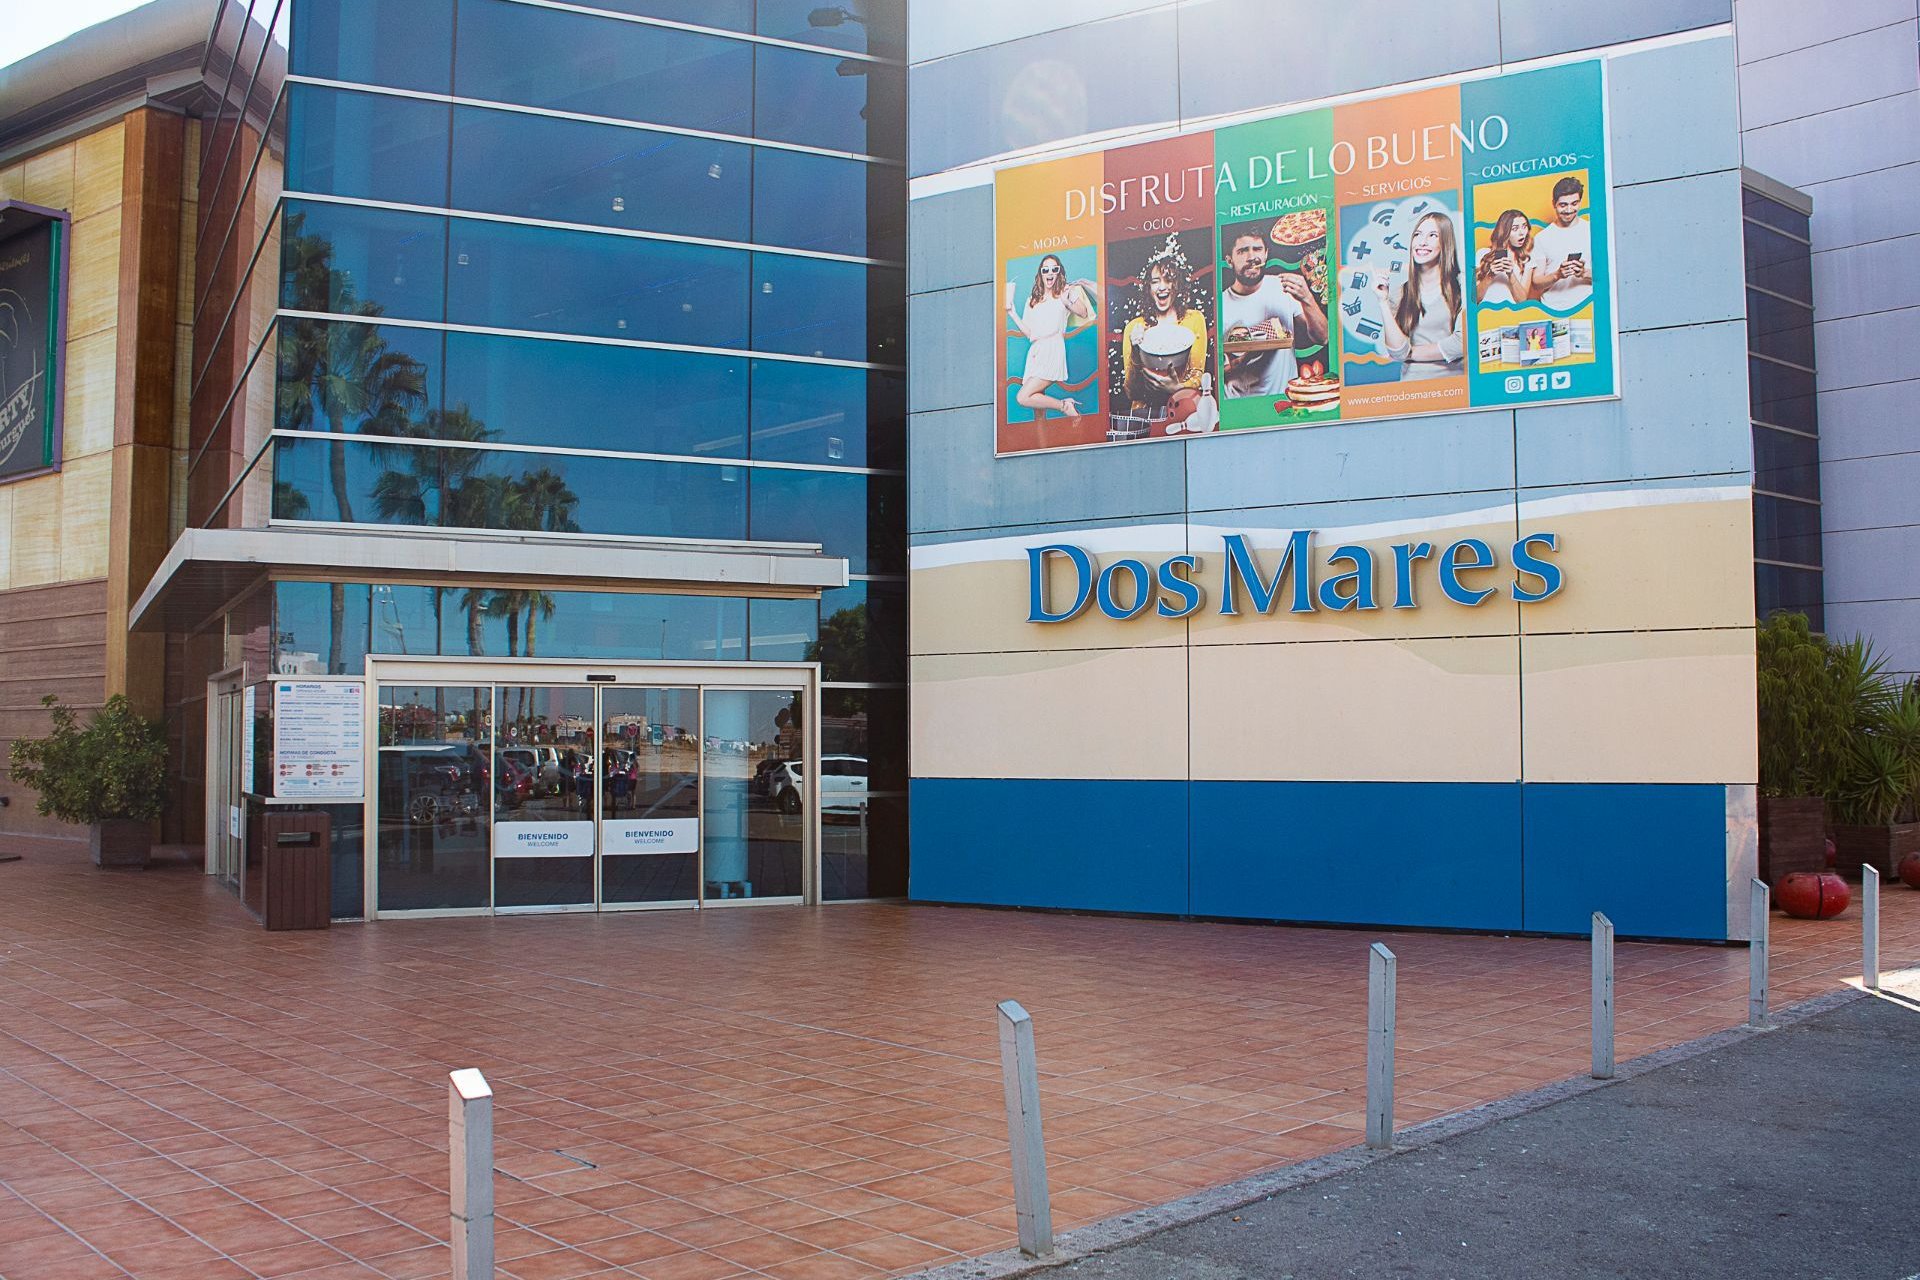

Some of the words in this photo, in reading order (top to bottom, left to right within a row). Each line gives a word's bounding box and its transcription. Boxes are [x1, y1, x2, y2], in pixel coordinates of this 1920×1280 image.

[1065, 162, 1237, 221] DISFRUTA
[1249, 149, 1297, 189] DE
[1308, 141, 1356, 180] LO
[1367, 115, 1508, 171] BUENO
[1482, 152, 1578, 178] CONECTADOS
[1362, 176, 1432, 197] SERVICIOS
[1230, 192, 1318, 217] RESTAURACIÓN
[1143, 216, 1175, 231] OCIO
[1033, 234, 1069, 250] MODA
[1347, 387, 1464, 406] www.centrodosmares.com
[1025, 543, 1204, 624] Dos
[1218, 529, 1565, 617] Mares
[518, 833, 569, 841] BIENVENIDO
[625, 830, 674, 838] BIENVENIDO
